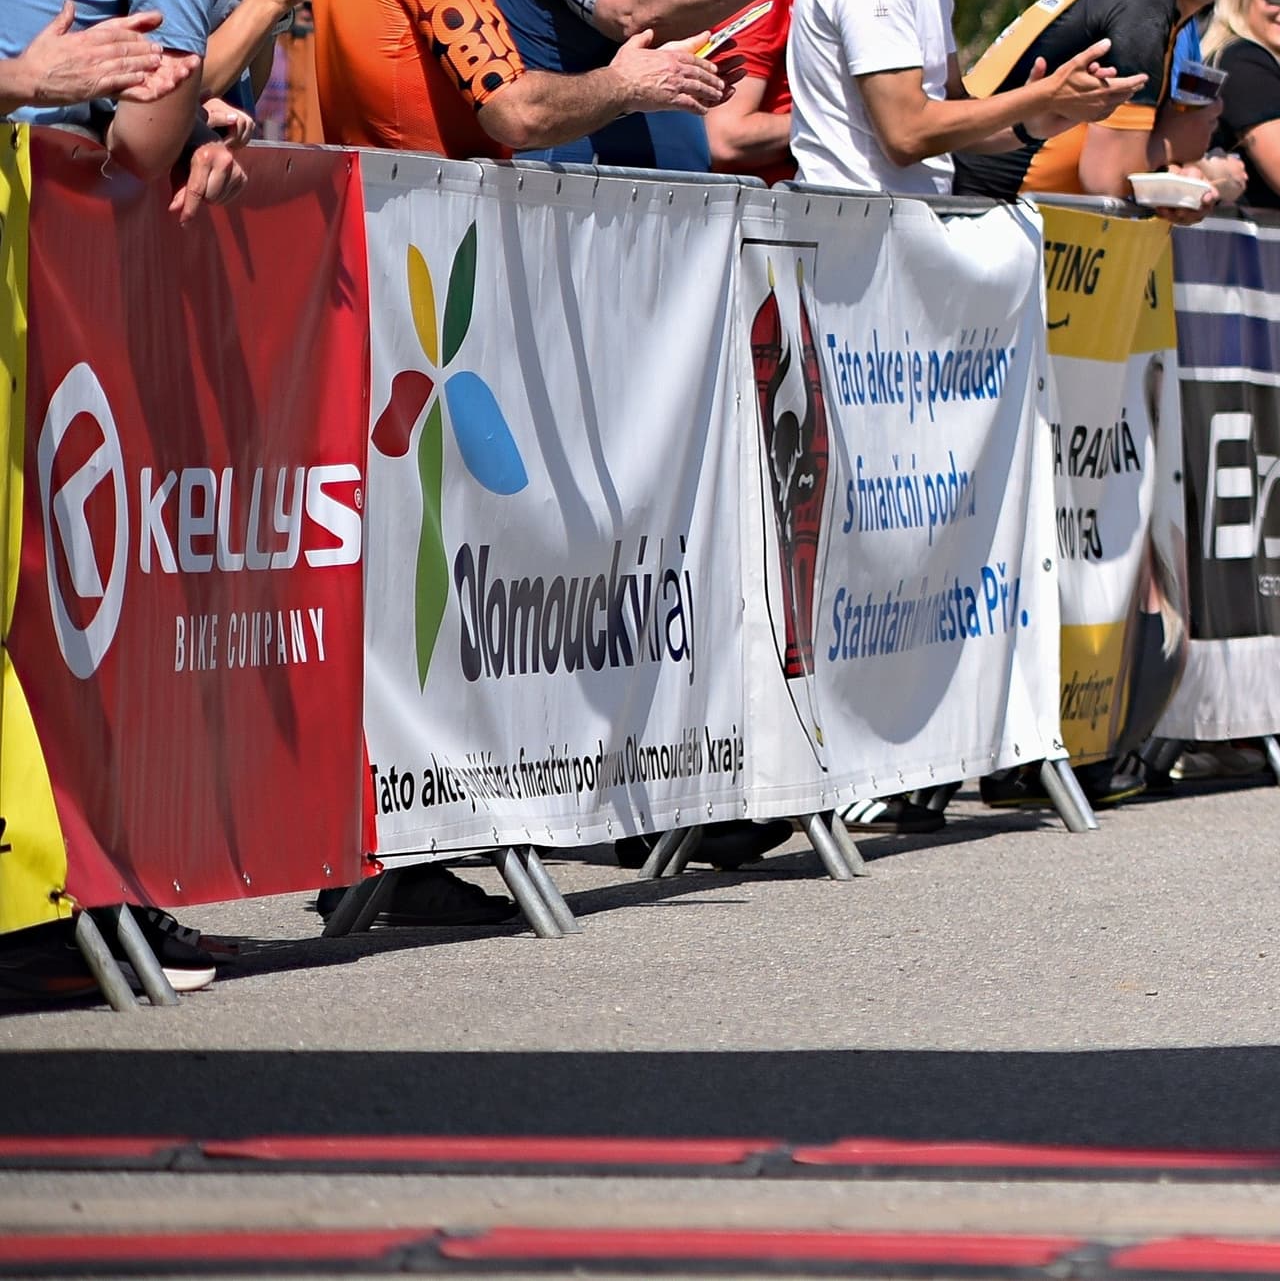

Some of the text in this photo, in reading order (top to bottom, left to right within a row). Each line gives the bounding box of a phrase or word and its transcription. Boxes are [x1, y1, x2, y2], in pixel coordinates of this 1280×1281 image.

[827, 327, 1016, 424] Tato akce je pořádán
[174, 607, 326, 672] BIKE COMPANY
[369, 763, 415, 816] Tato
[421, 752, 466, 809] akce
[704, 723, 745, 786] kraje
